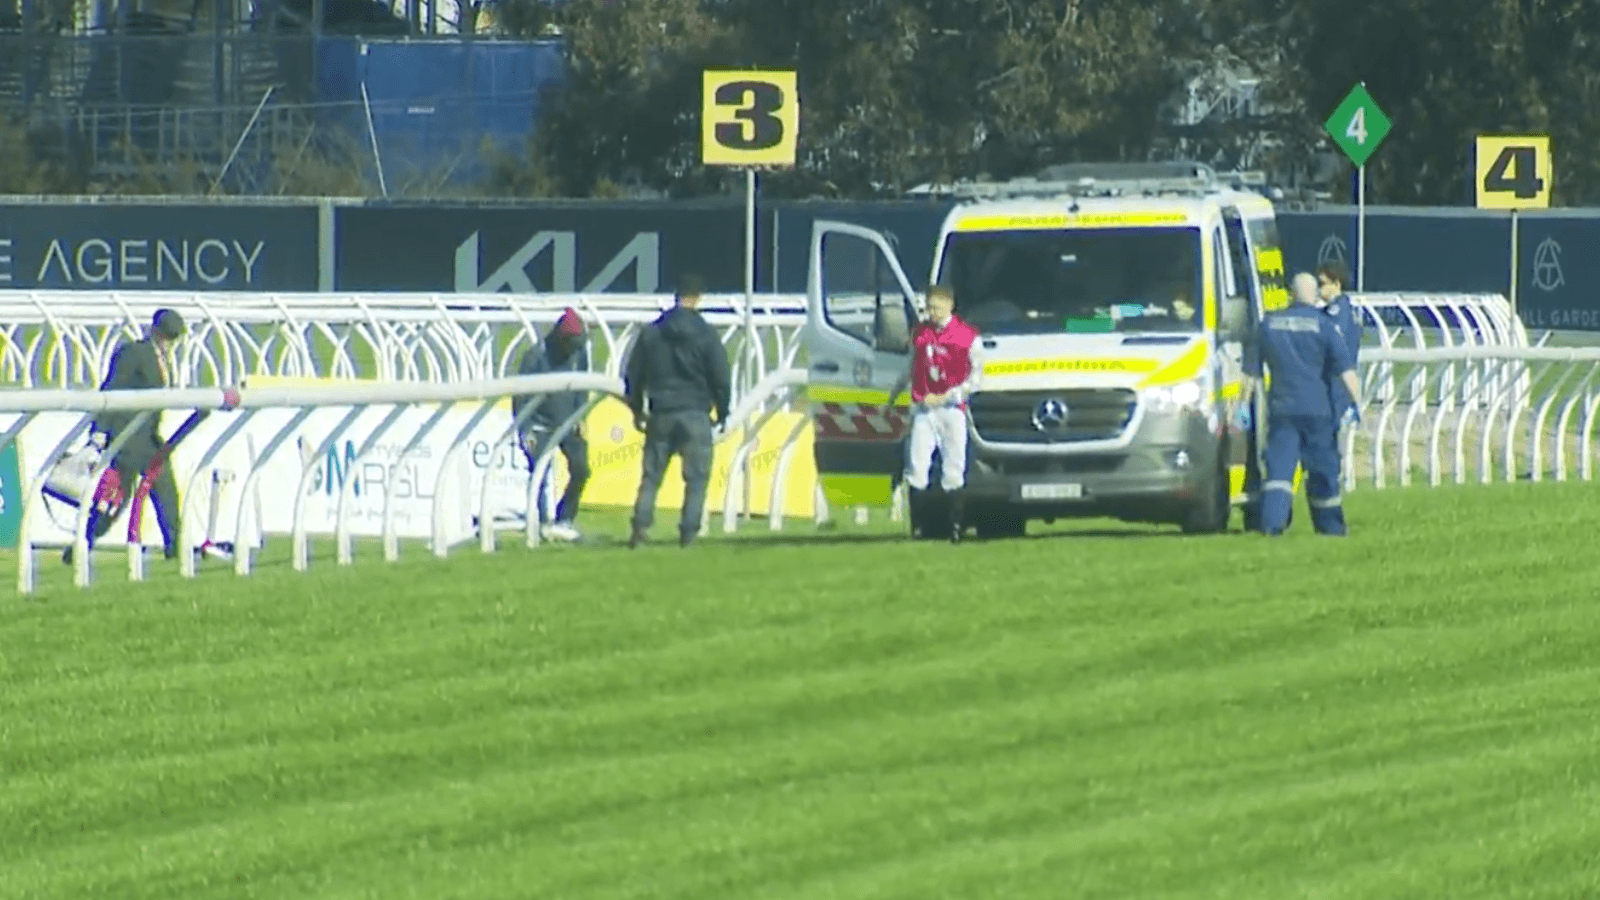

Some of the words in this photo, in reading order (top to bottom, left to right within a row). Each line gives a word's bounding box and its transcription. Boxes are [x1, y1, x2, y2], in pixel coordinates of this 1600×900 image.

[715, 81, 784, 150] 3
[1346, 107, 1368, 145] 4
[1484, 146, 1544, 199] 4
[37, 239, 264, 283] AGENCY
